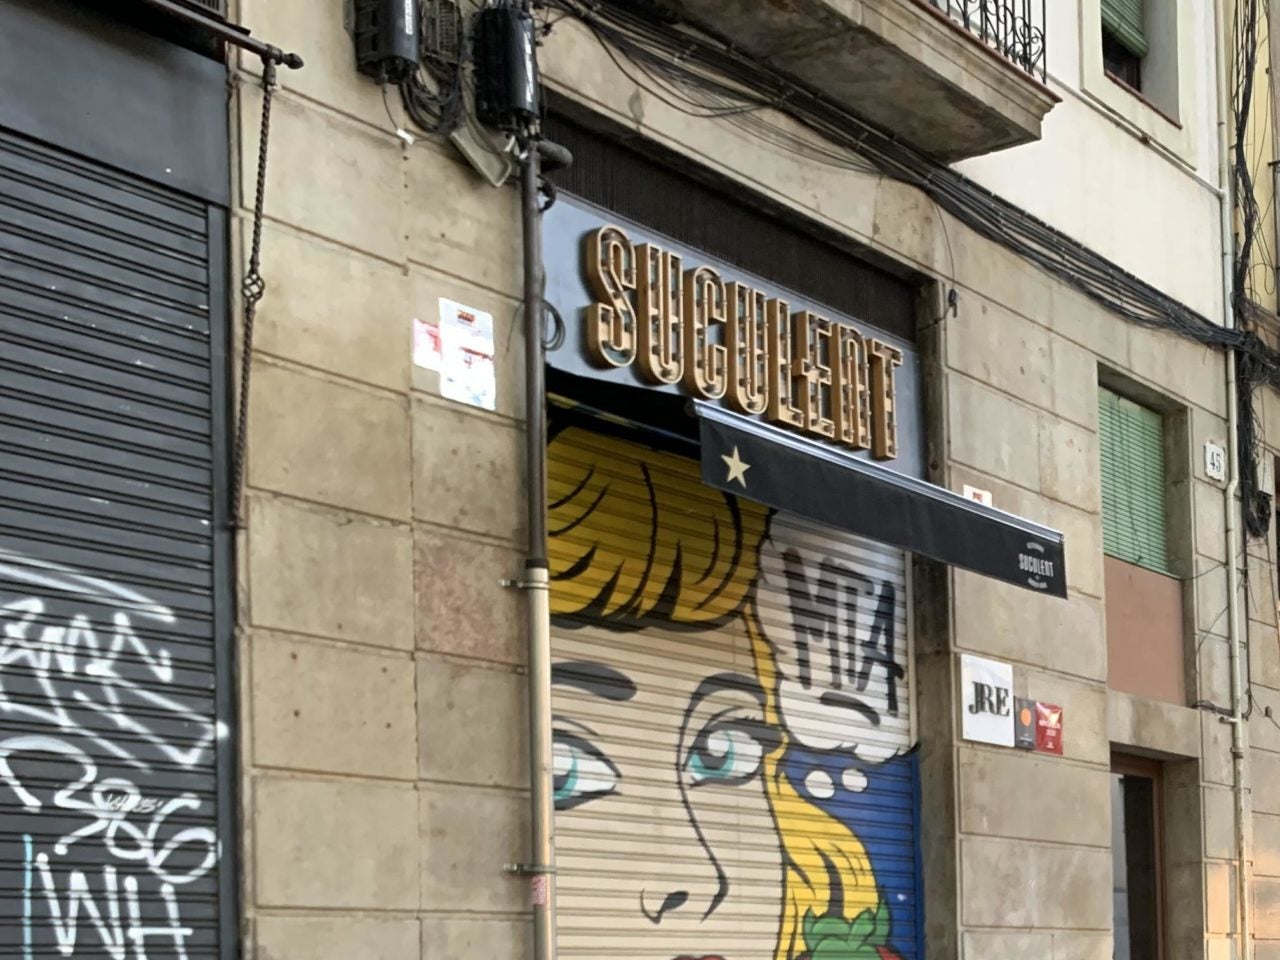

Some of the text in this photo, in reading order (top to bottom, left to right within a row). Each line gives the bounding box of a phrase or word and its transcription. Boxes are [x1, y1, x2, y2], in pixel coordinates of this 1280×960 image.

[587, 224, 903, 460] SUCULENT
[1209, 450, 1221, 473] 45
[1018, 553, 1055, 578] SUCULENT
[968, 680, 1011, 718] JRE
